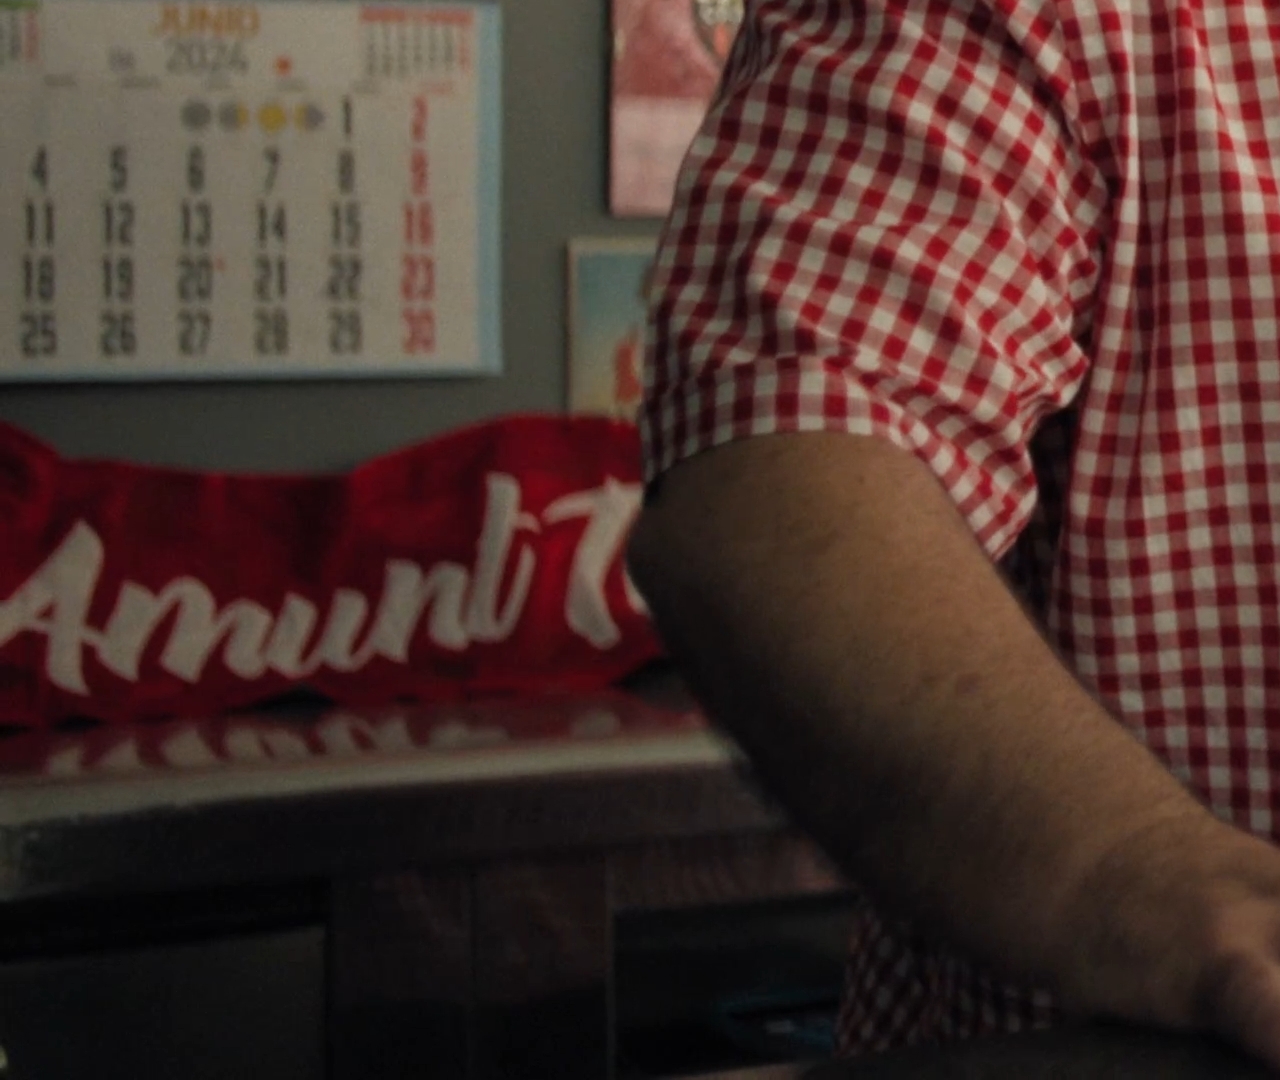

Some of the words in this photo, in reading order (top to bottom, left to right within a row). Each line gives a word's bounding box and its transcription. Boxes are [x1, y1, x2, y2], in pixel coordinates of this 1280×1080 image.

[156, 2, 262, 39] JUNIO
[166, 41, 249, 74] 2024
[411, 94, 428, 140] 2
[32, 145, 48, 192] 4
[109, 145, 129, 192] 5
[186, 145, 205, 192] 6
[261, 145, 281, 192] 7
[24, 201, 56, 248] 11
[102, 201, 135, 248] 12
[180, 201, 212, 248] 13
[256, 201, 288, 248] 14
[331, 201, 363, 248] 15
[403, 201, 435, 248] 16
[23, 254, 56, 302] 18
[102, 254, 134, 302] 19
[178, 254, 213, 302] 20
[254, 254, 288, 302] 21
[328, 254, 363, 302] 22
[20, 307, 58, 357] 25
[101, 307, 137, 357] 26
[178, 307, 213, 357] 27
[254, 307, 290, 357] 28
[328, 307, 364, 357] 29
[0, 472, 540, 696] Amunt
